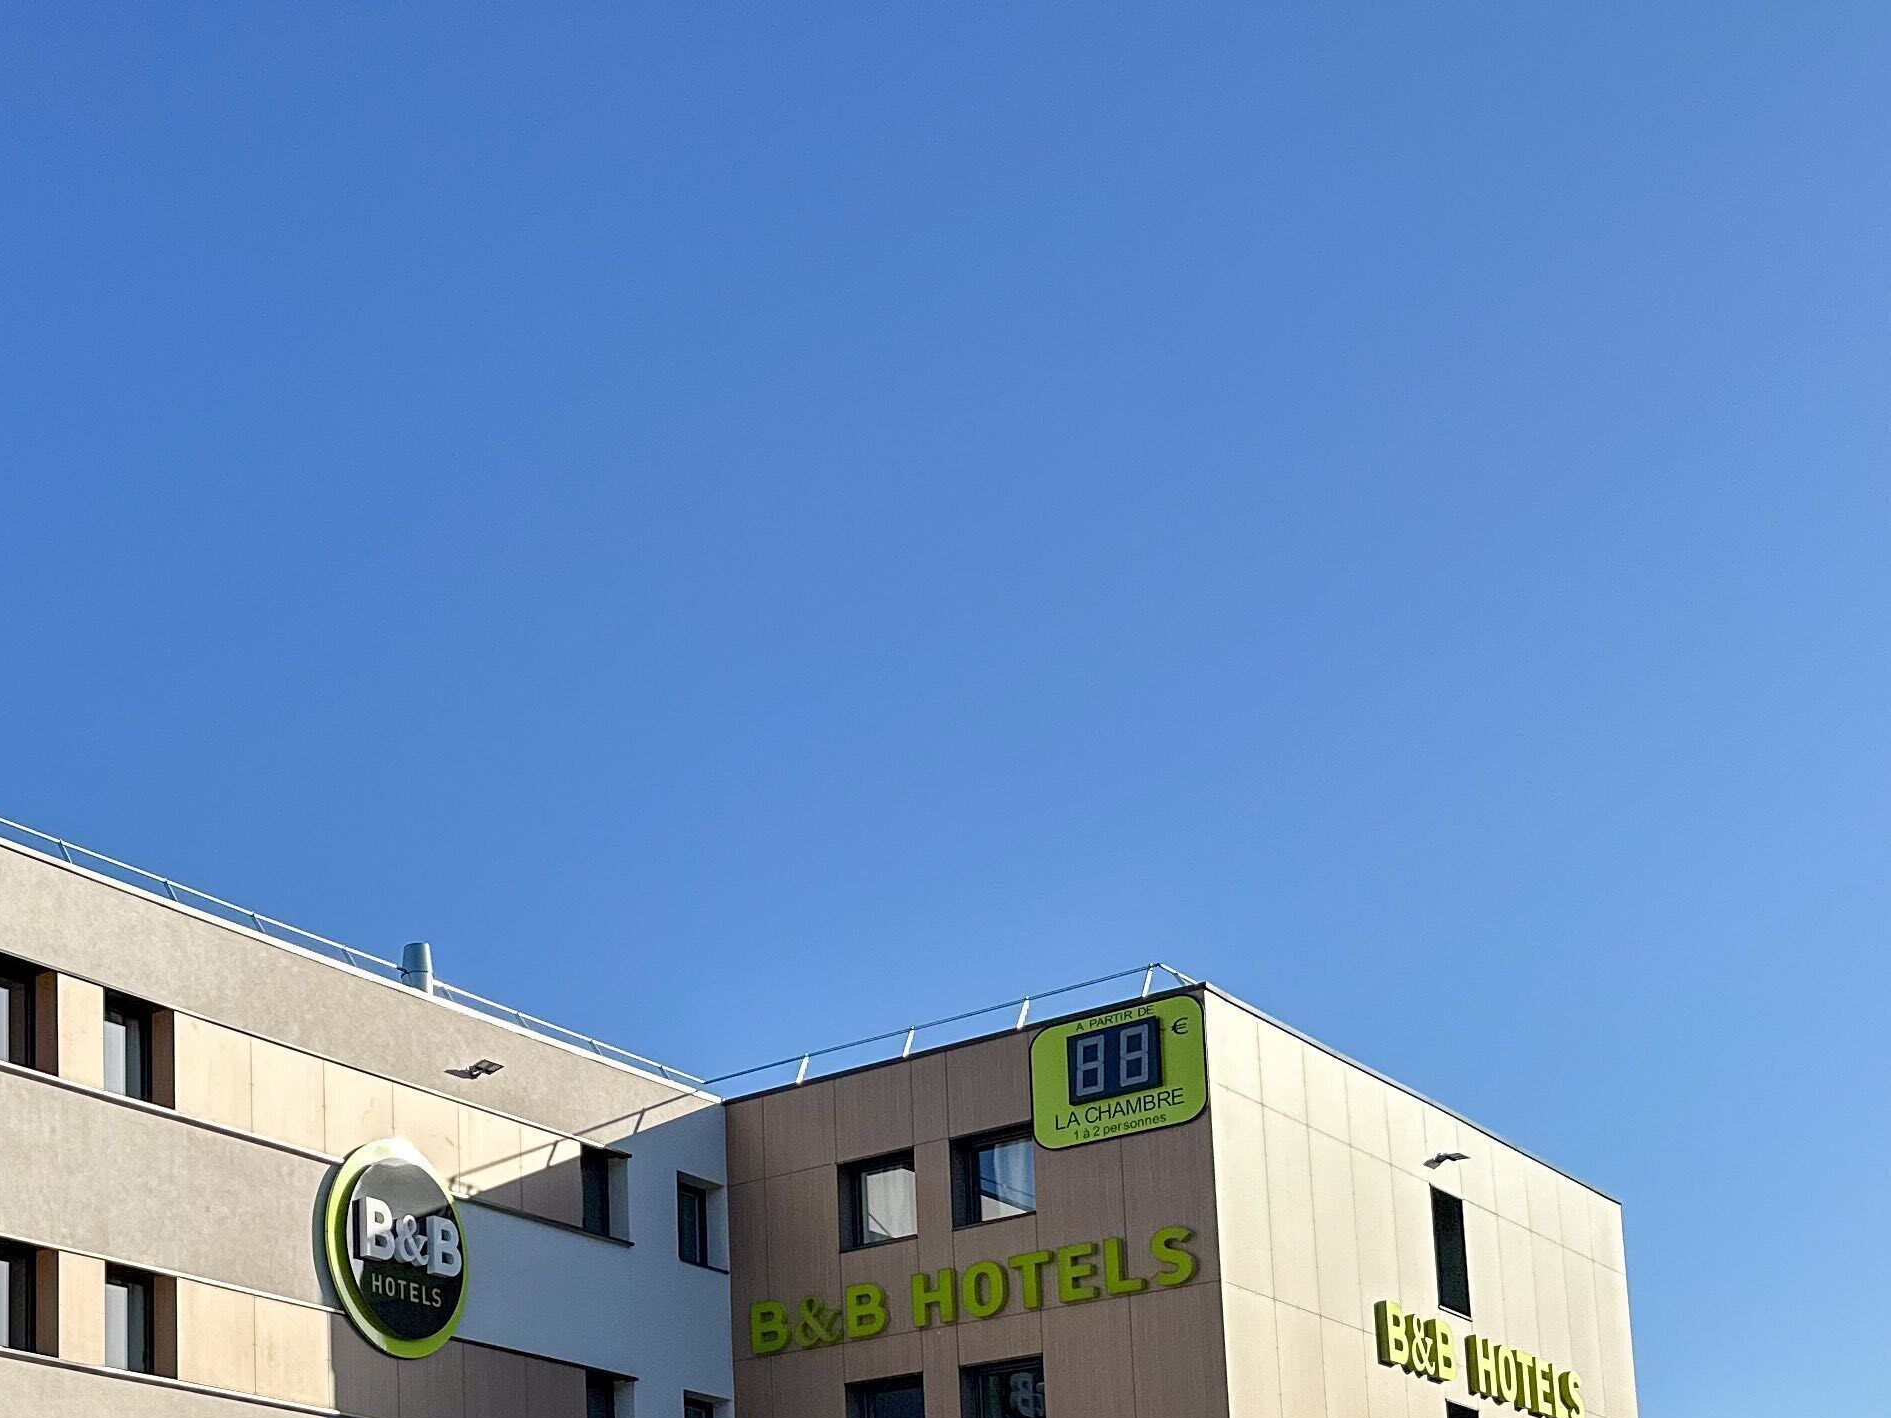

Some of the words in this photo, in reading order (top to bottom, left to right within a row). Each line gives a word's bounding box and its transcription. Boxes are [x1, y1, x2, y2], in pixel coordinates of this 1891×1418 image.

[1075, 1021, 1085, 1032] A
[1089, 1010, 1133, 1028] PARTIR
[1137, 1004, 1155, 1017] DE
[1171, 1017, 1189, 1035] €
[1055, 1111, 1080, 1131] LA
[1084, 1088, 1185, 1124] CHAMBRE
[1073, 1130, 1079, 1140] 1
[1082, 1126, 1090, 1139] à
[1093, 1126, 1100, 1138] 2
[1103, 1114, 1167, 1136] personnes
[361, 1196, 462, 1277] B&B
[371, 1273, 442, 1308] HOTELS
[750, 1282, 889, 1354] B&B
[911, 1224, 1198, 1328] HOTELS
[1374, 1300, 1456, 1384] B&B
